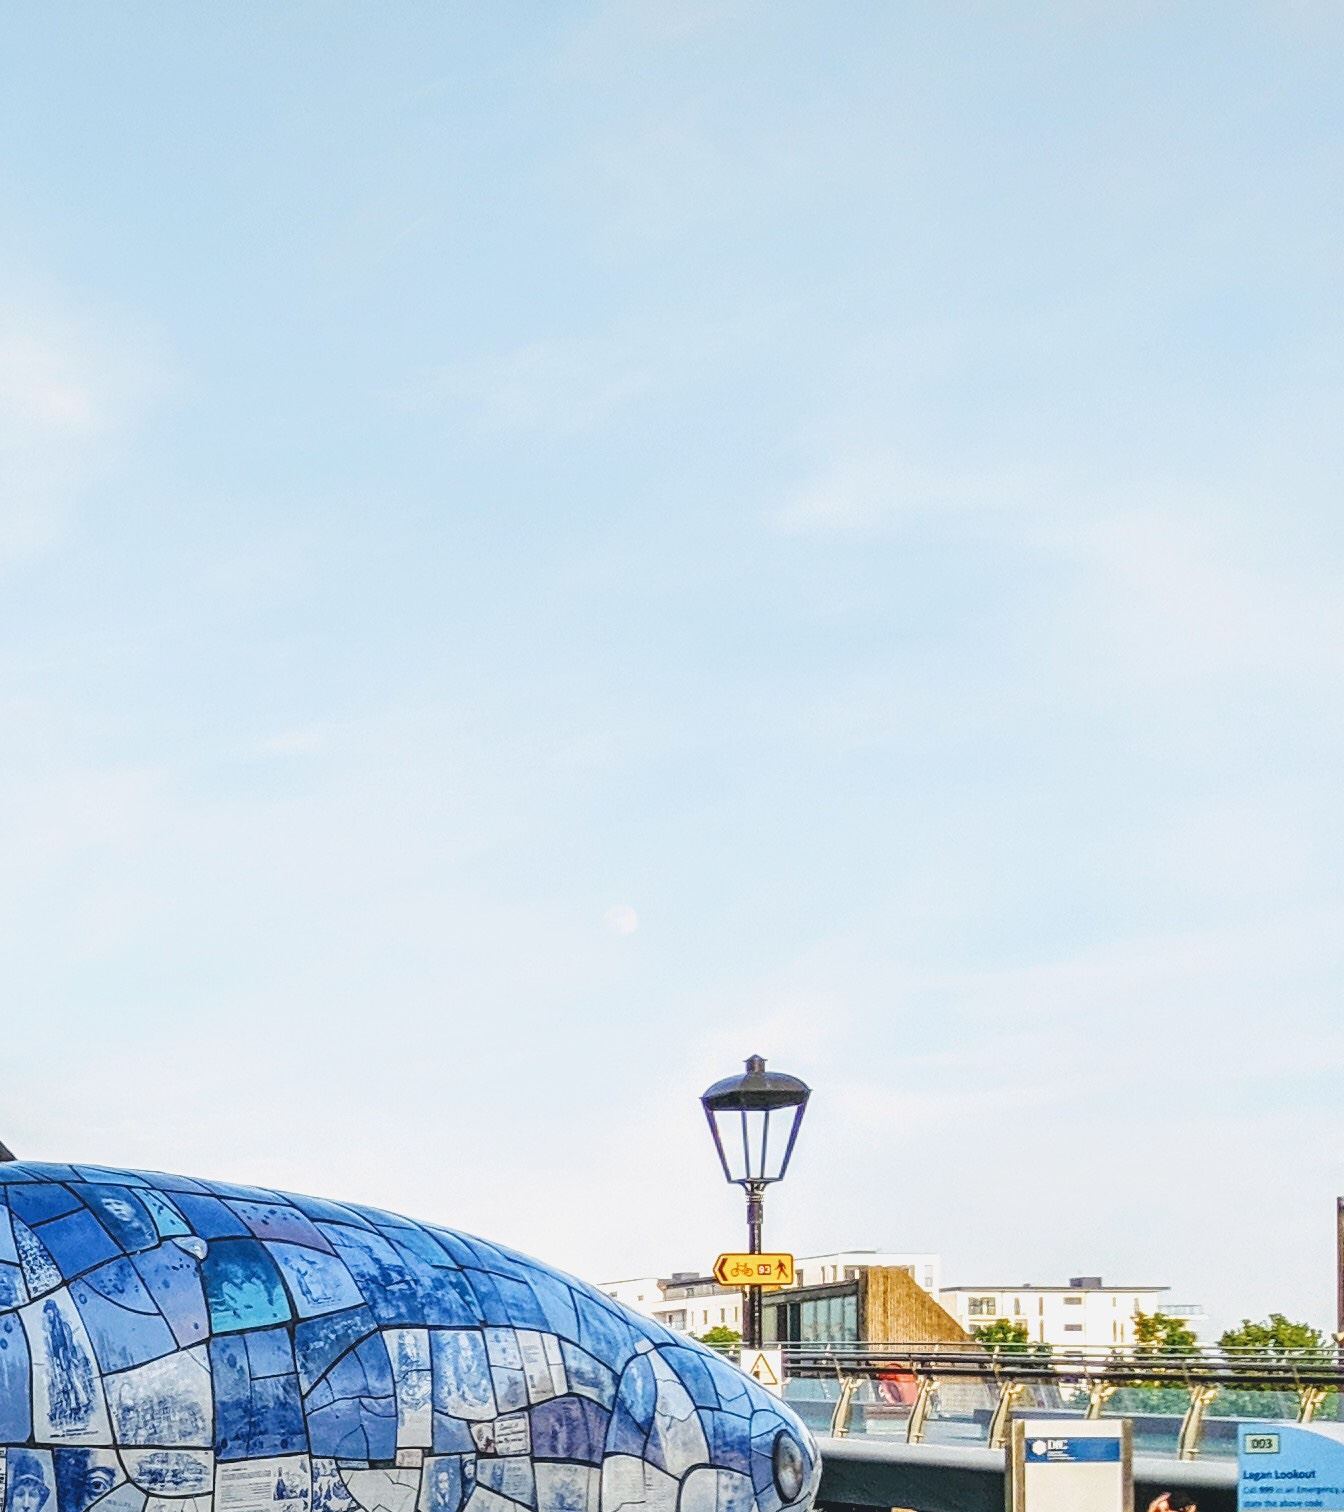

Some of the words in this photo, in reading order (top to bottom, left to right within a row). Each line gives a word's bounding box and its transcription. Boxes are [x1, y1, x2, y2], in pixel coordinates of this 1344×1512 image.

[1251, 1438, 1273, 1449] 003
[1243, 1470, 1273, 1481] Lagan
[1274, 1469, 1316, 1479] Lookout
